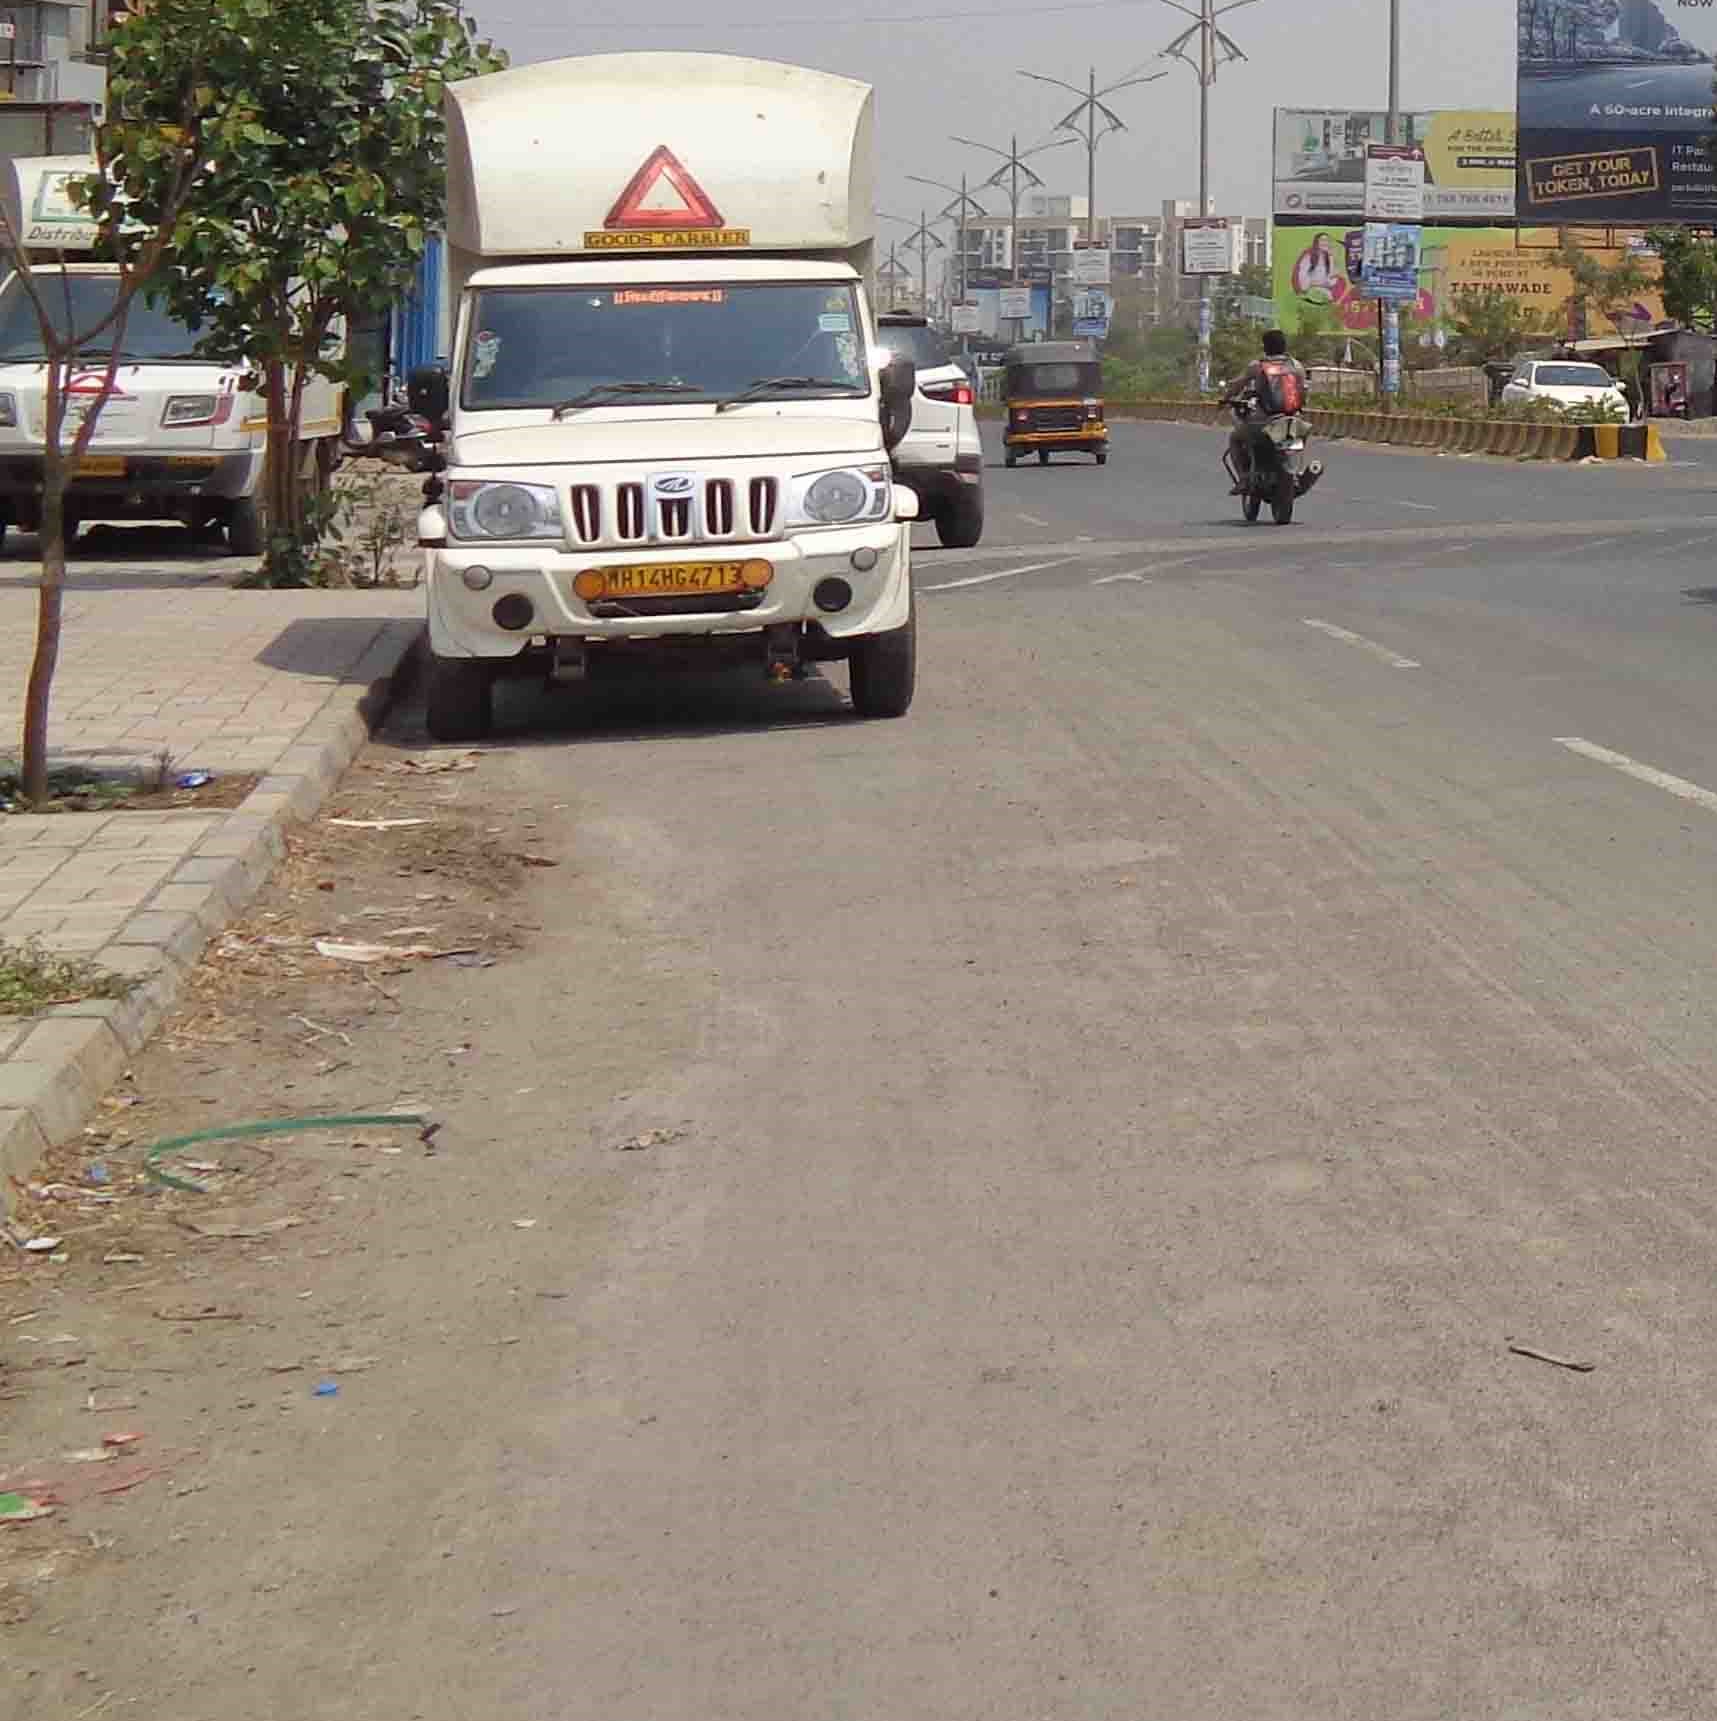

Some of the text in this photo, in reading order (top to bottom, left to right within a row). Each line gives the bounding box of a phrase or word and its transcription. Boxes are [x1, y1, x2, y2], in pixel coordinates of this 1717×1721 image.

[1590, 103, 1600, 114] A
[1552, 157, 1632, 178] GET YOUR
[1600, 170, 1650, 187] TODAY
[588, 231, 746, 247] GOODS CARRIER
